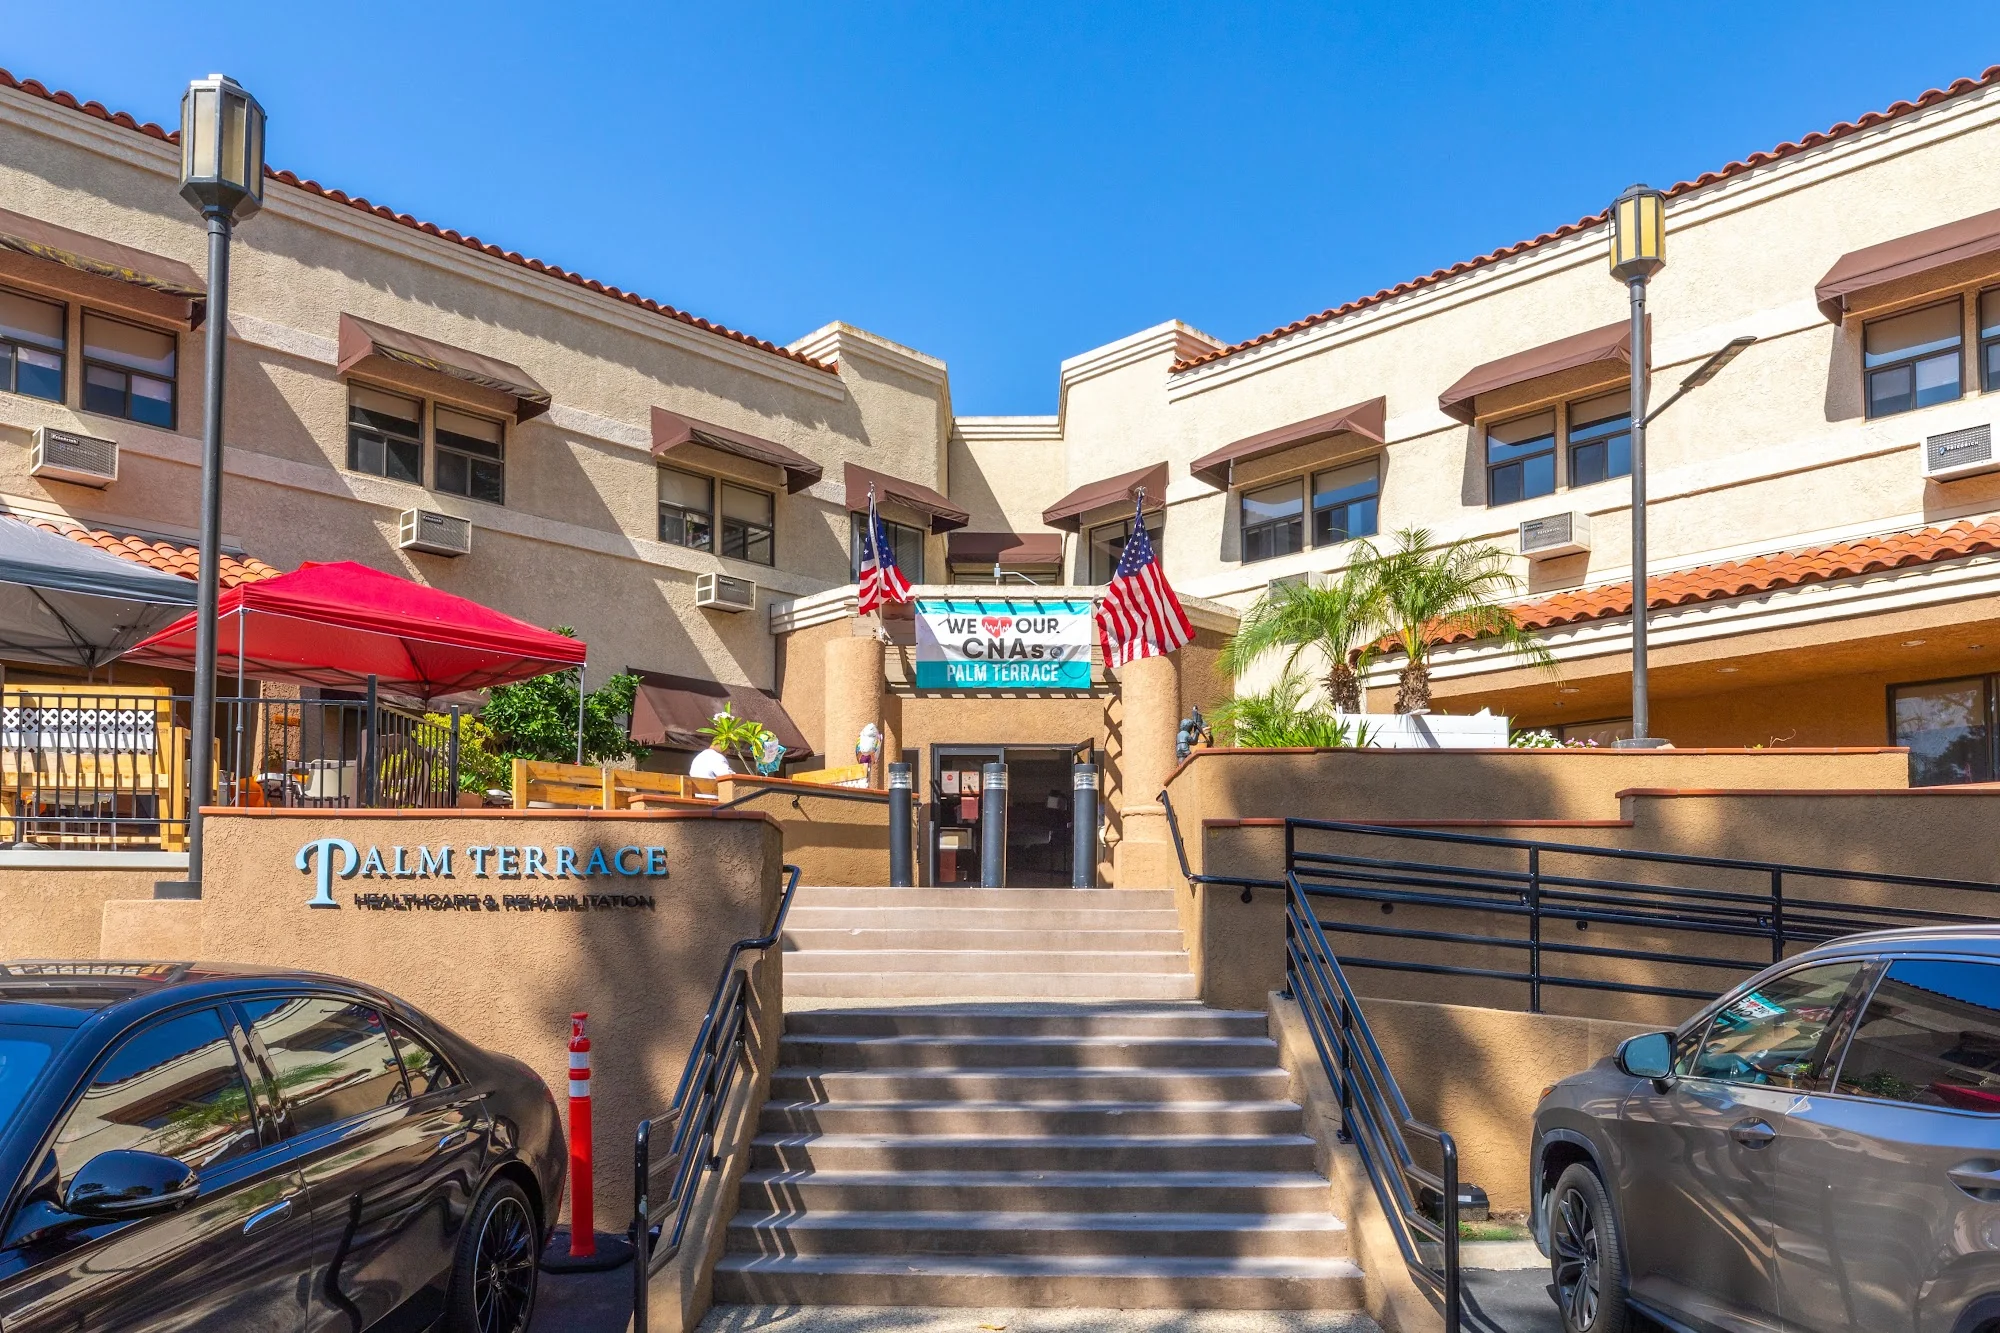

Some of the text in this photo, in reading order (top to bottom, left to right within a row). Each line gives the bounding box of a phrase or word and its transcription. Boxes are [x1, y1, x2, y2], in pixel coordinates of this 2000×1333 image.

[947, 617, 1060, 634] WE OUR
[962, 637, 1044, 660] CNAs
[947, 663, 1060, 682] PALM TERRACE
[294, 838, 667, 905] PALM TERRACE
[354, 893, 654, 909] HEALTHCARE & REHABILITATION
